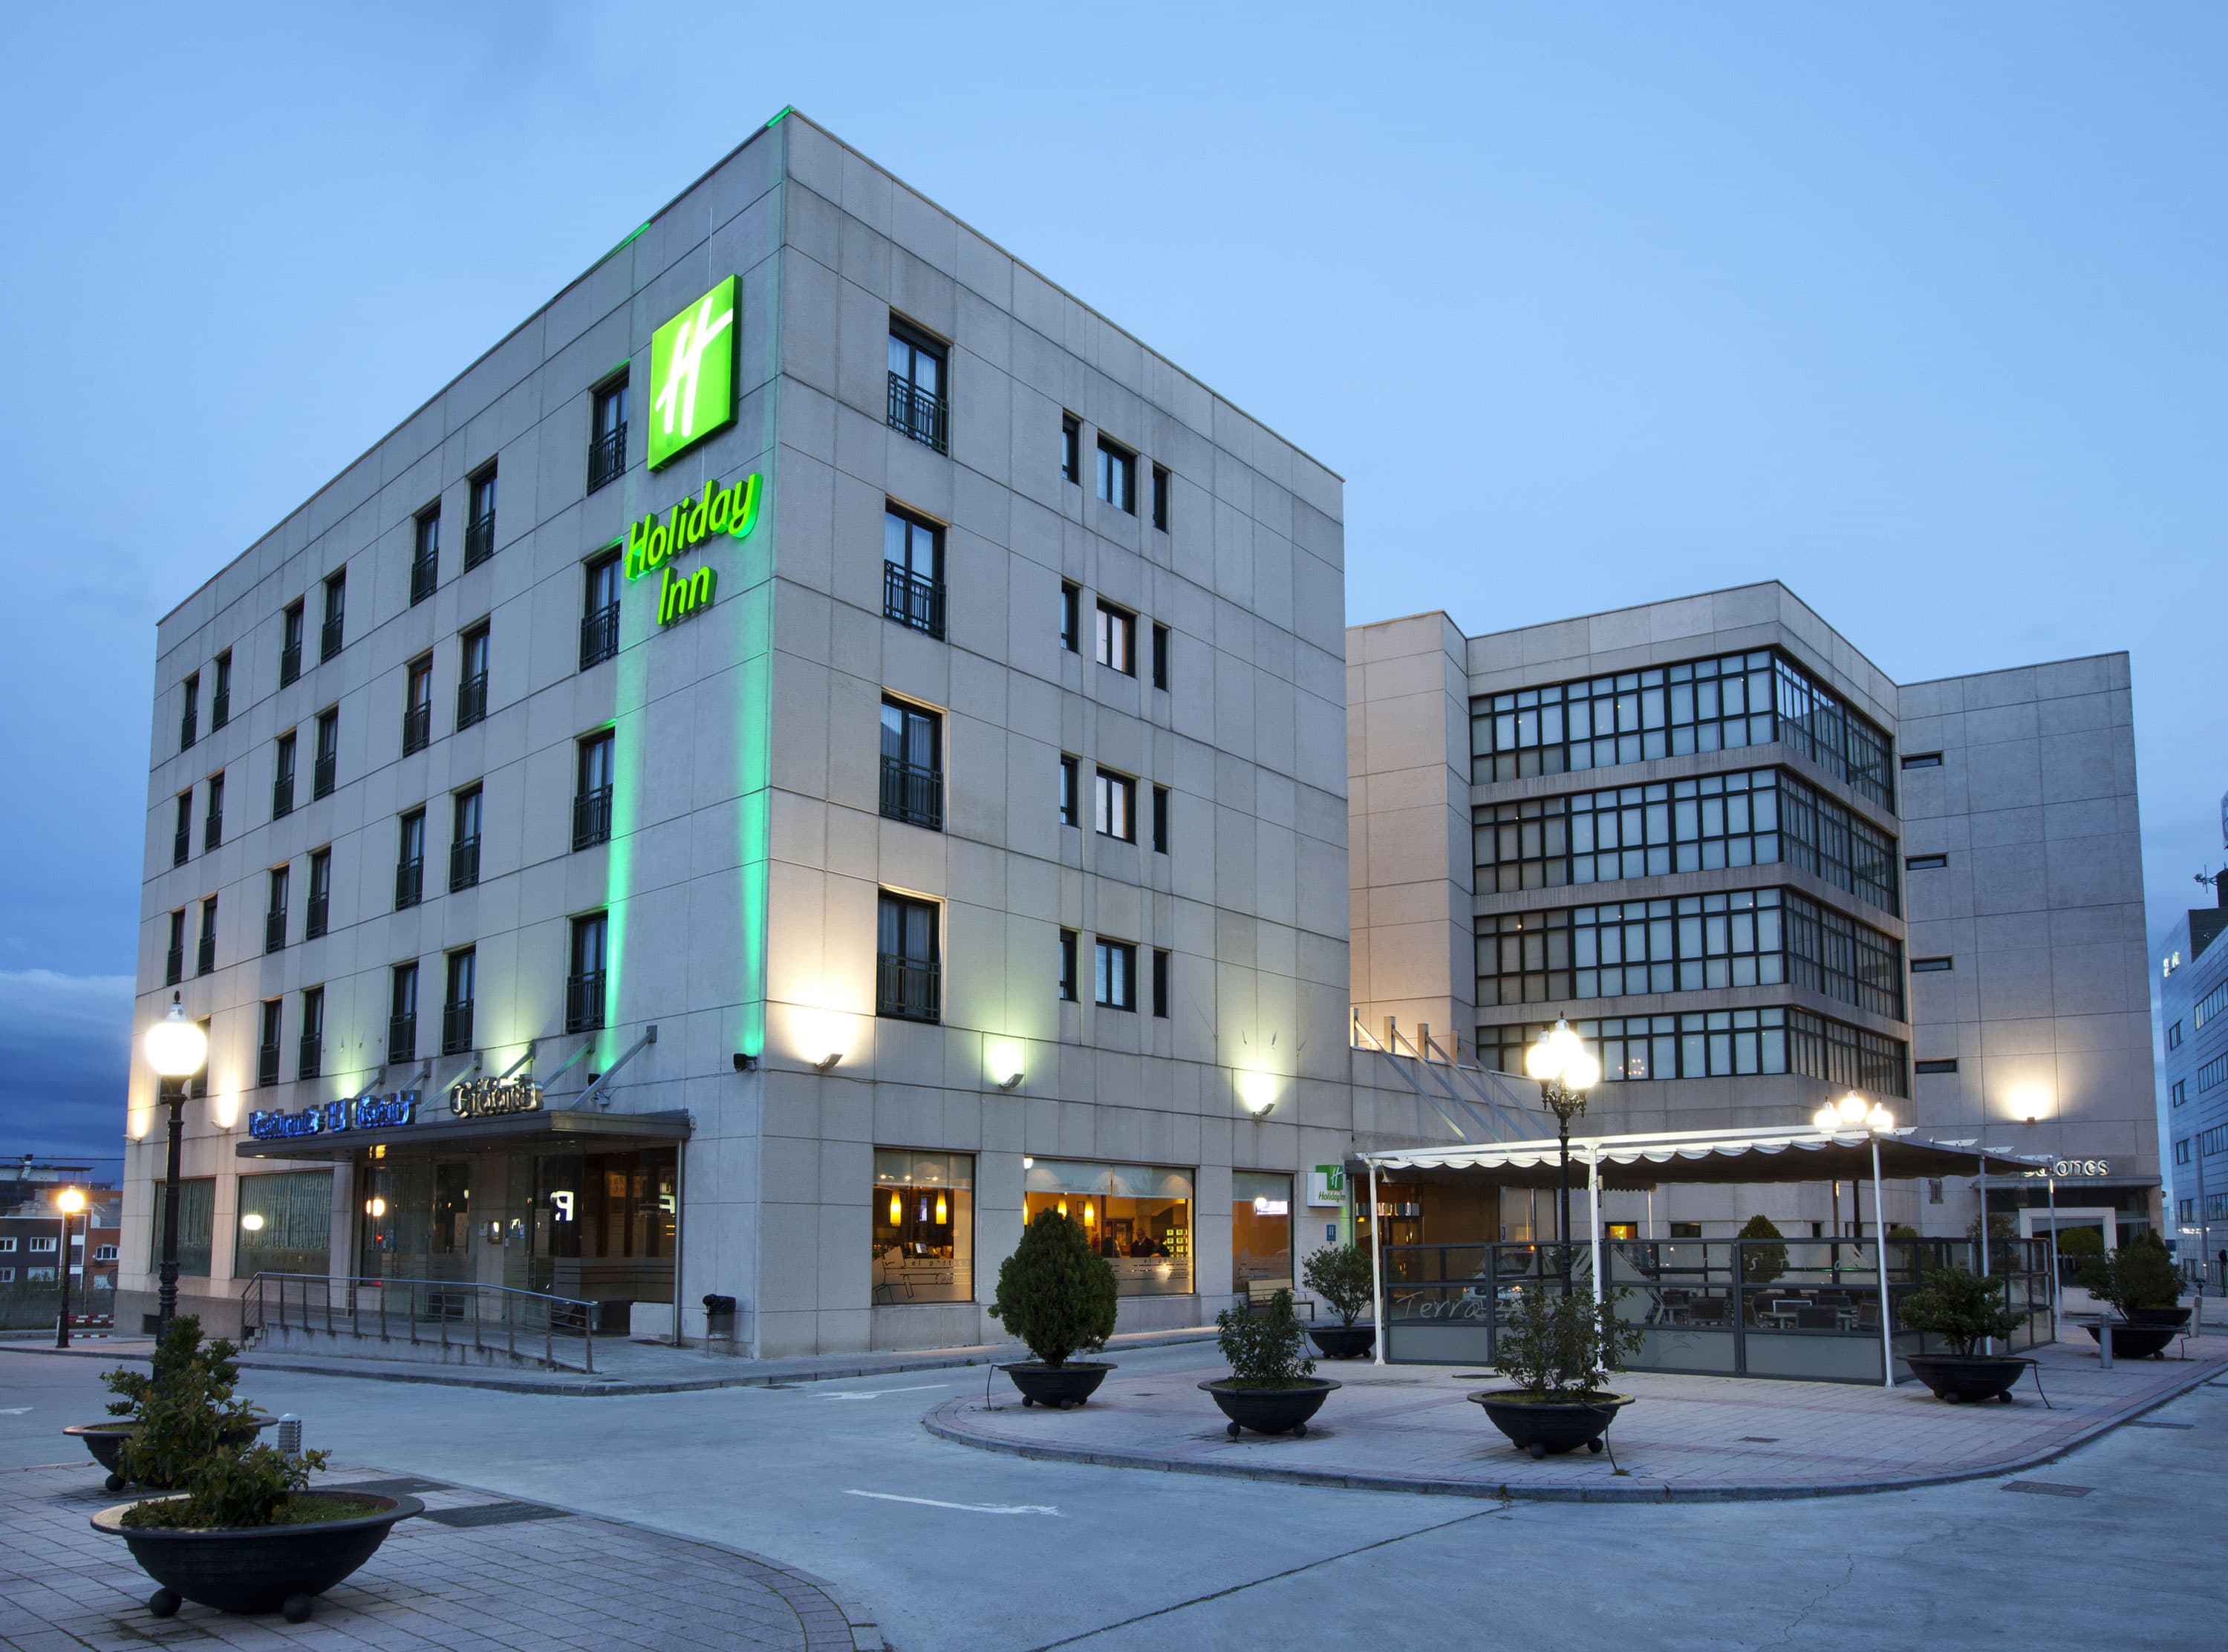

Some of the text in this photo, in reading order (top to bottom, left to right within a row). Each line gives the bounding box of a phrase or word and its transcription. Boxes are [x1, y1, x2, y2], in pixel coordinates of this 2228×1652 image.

[624, 472, 763, 581] Holiday
[657, 566, 717, 628] Inn
[1318, 1191, 1341, 1203] Holiday
